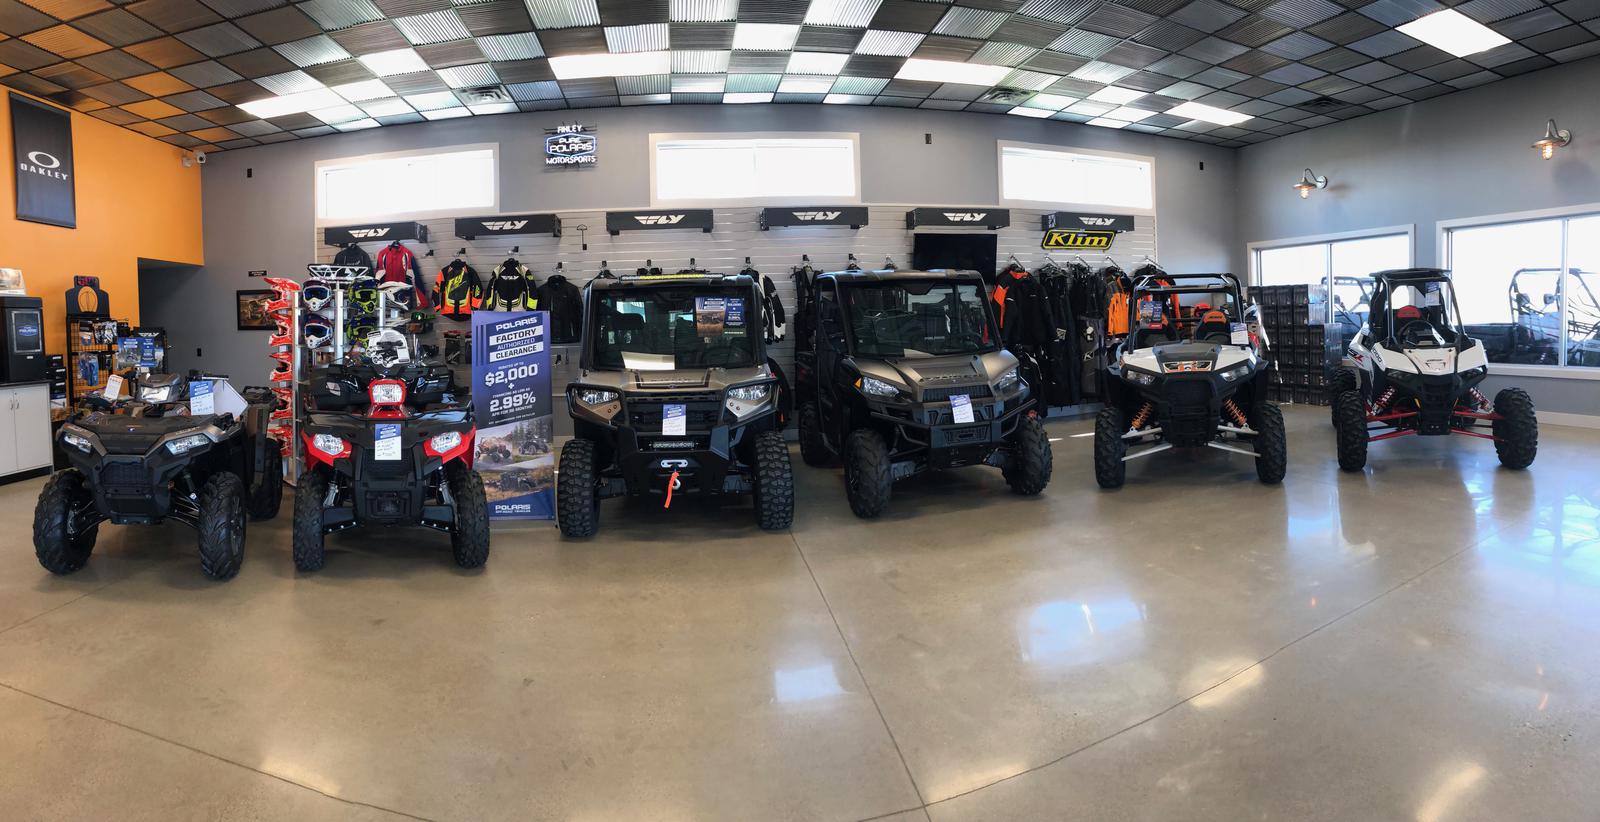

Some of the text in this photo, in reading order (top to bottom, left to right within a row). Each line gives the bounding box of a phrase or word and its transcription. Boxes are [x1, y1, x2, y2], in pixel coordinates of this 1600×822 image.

[550, 143, 592, 152] POLARIS
[546, 156, 596, 164] MOTORSPORTS
[21, 163, 68, 180] OAKLEY
[634, 214, 685, 224] FLY
[792, 211, 841, 220] FLY
[943, 212, 987, 221] FLY
[1079, 216, 1115, 225] FLY
[481, 220, 528, 230] FLY
[348, 228, 390, 238] FLY
[1048, 232, 1108, 246] Klim
[496, 316, 537, 331] POLARIS
[496, 328, 536, 343] FACTORY
[497, 338, 535, 350] AUTHORIZED
[496, 345, 537, 359] CLEARANCE
[490, 391, 536, 412] 2.99%
